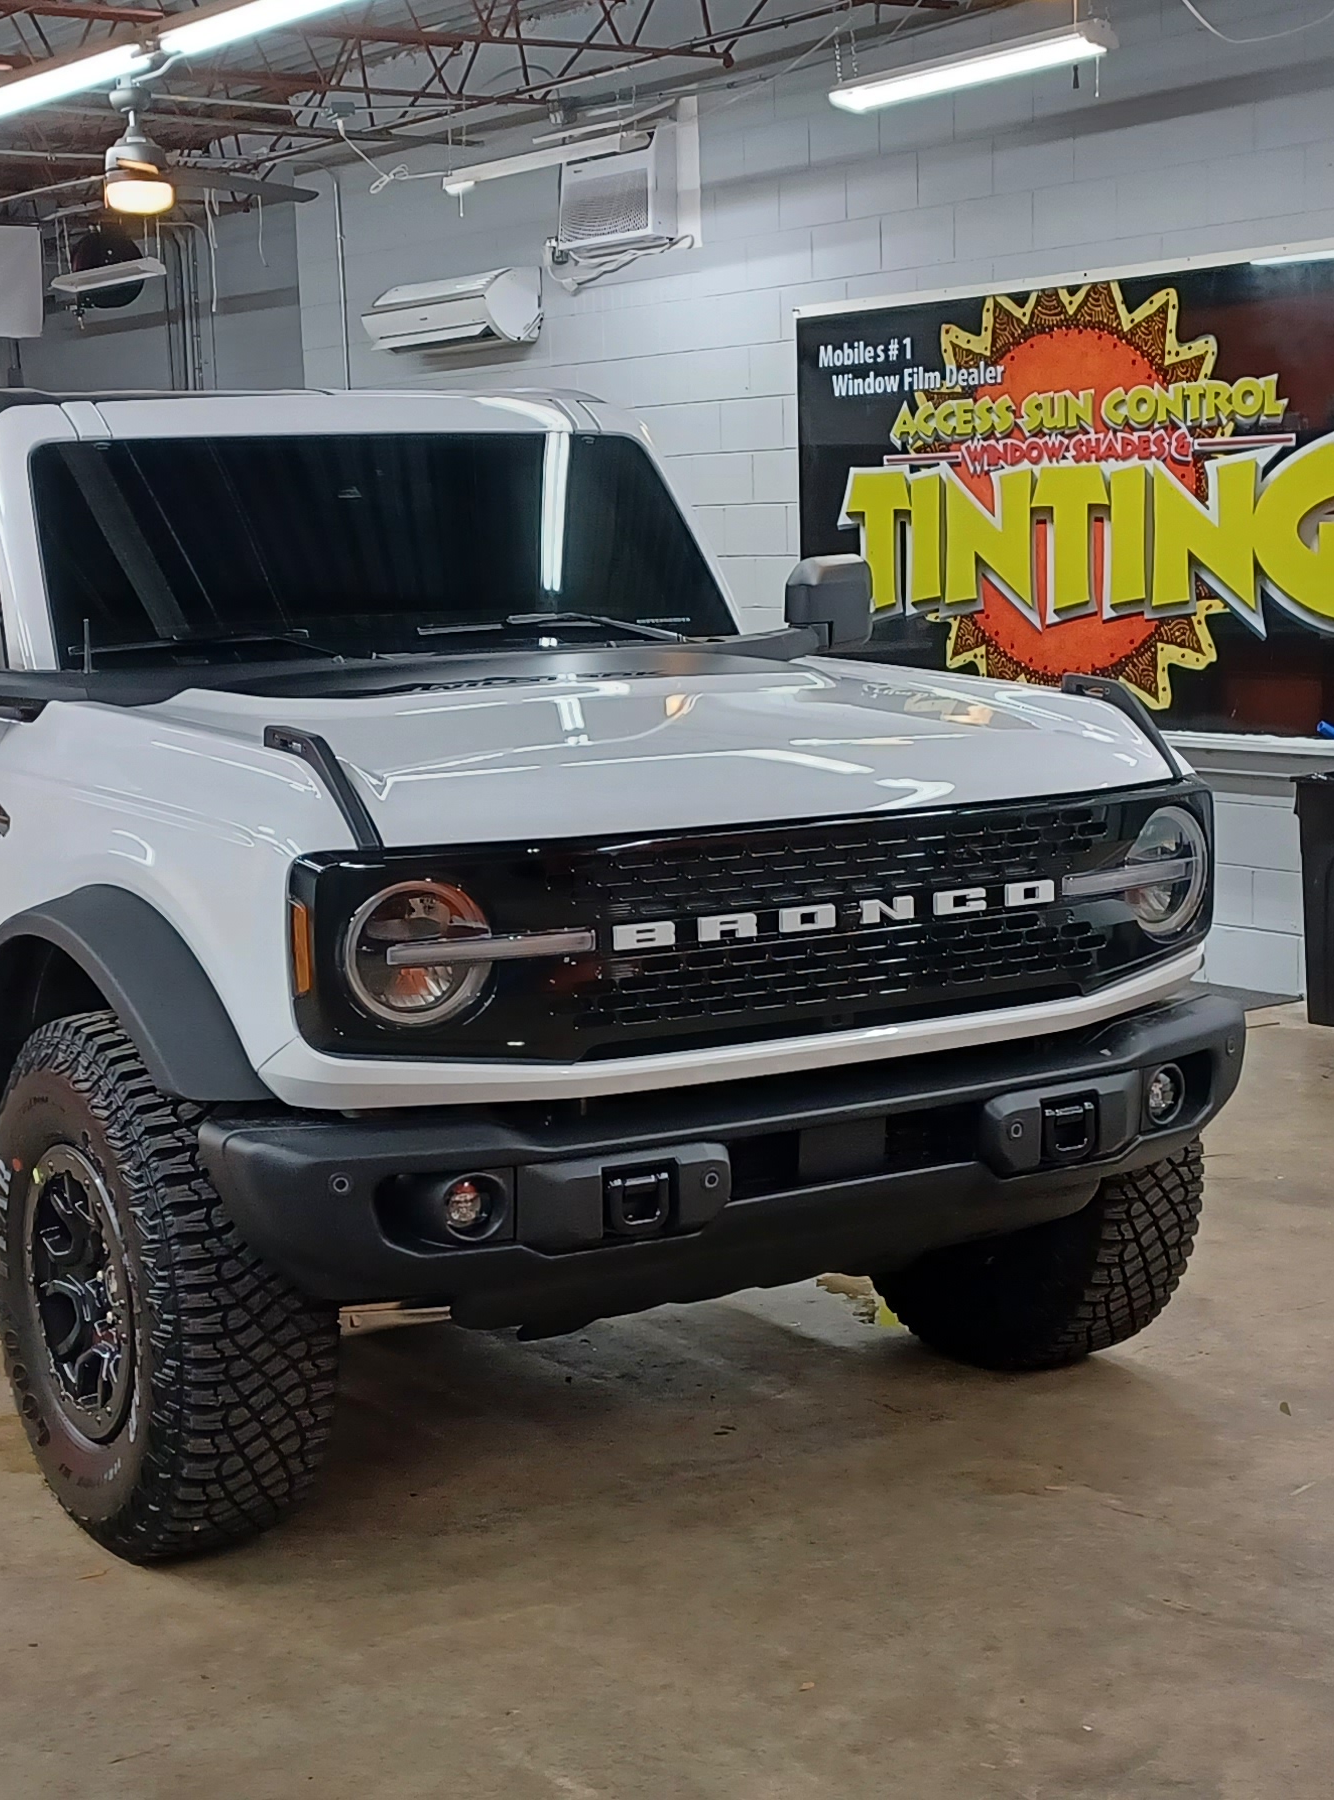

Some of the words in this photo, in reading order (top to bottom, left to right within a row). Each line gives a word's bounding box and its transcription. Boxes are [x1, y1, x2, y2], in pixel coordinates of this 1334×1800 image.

[832, 371, 900, 397] Window
[903, 366, 941, 391] Film
[945, 361, 1005, 387] Dealer
[891, 395, 1015, 446] ACCESS
[1021, 389, 1095, 436] SUN
[1102, 374, 1288, 428] CONTROL
[963, 436, 1068, 472] WINDOW
[1070, 430, 1168, 463] SHADES
[1171, 429, 1193, 464] &
[612, 879, 1055, 951] BRONCO
